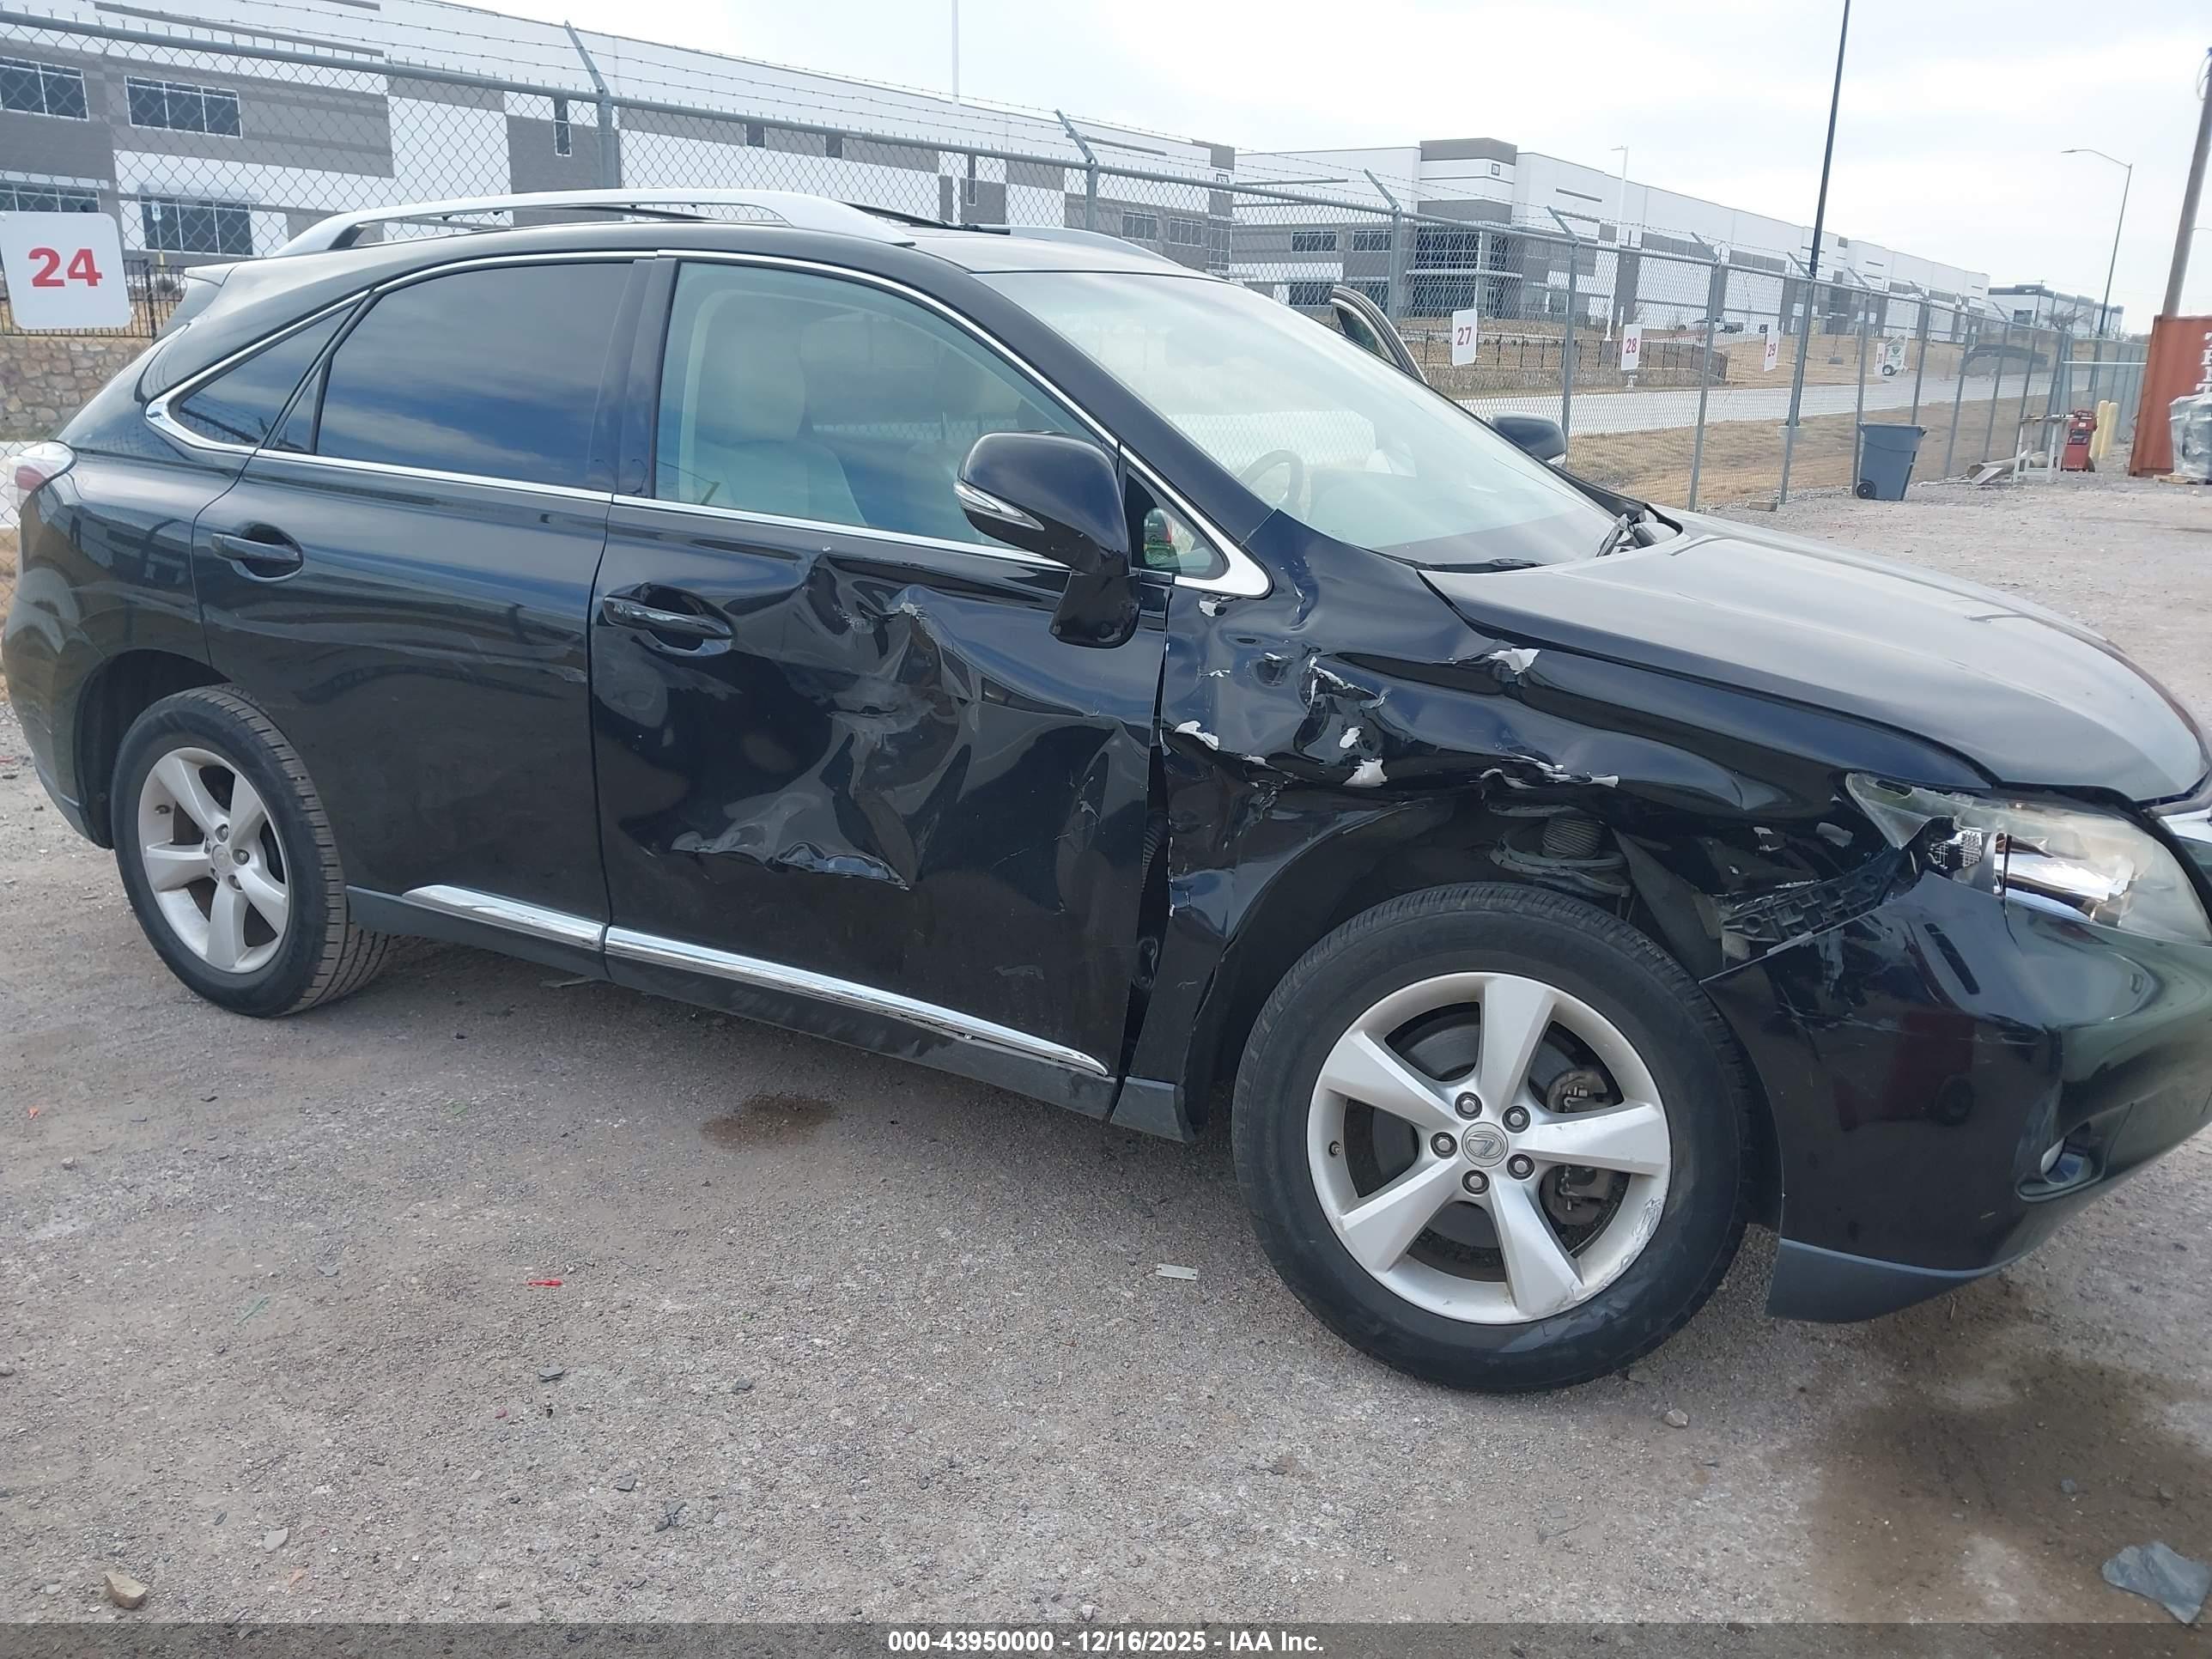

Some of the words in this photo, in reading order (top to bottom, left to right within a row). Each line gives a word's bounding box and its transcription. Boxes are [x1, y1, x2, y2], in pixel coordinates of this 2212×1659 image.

[28, 247, 103, 287] 24
[1456, 325, 1472, 346] 27
[1626, 337, 1638, 354] 28
[1767, 343, 1777, 357] 29
